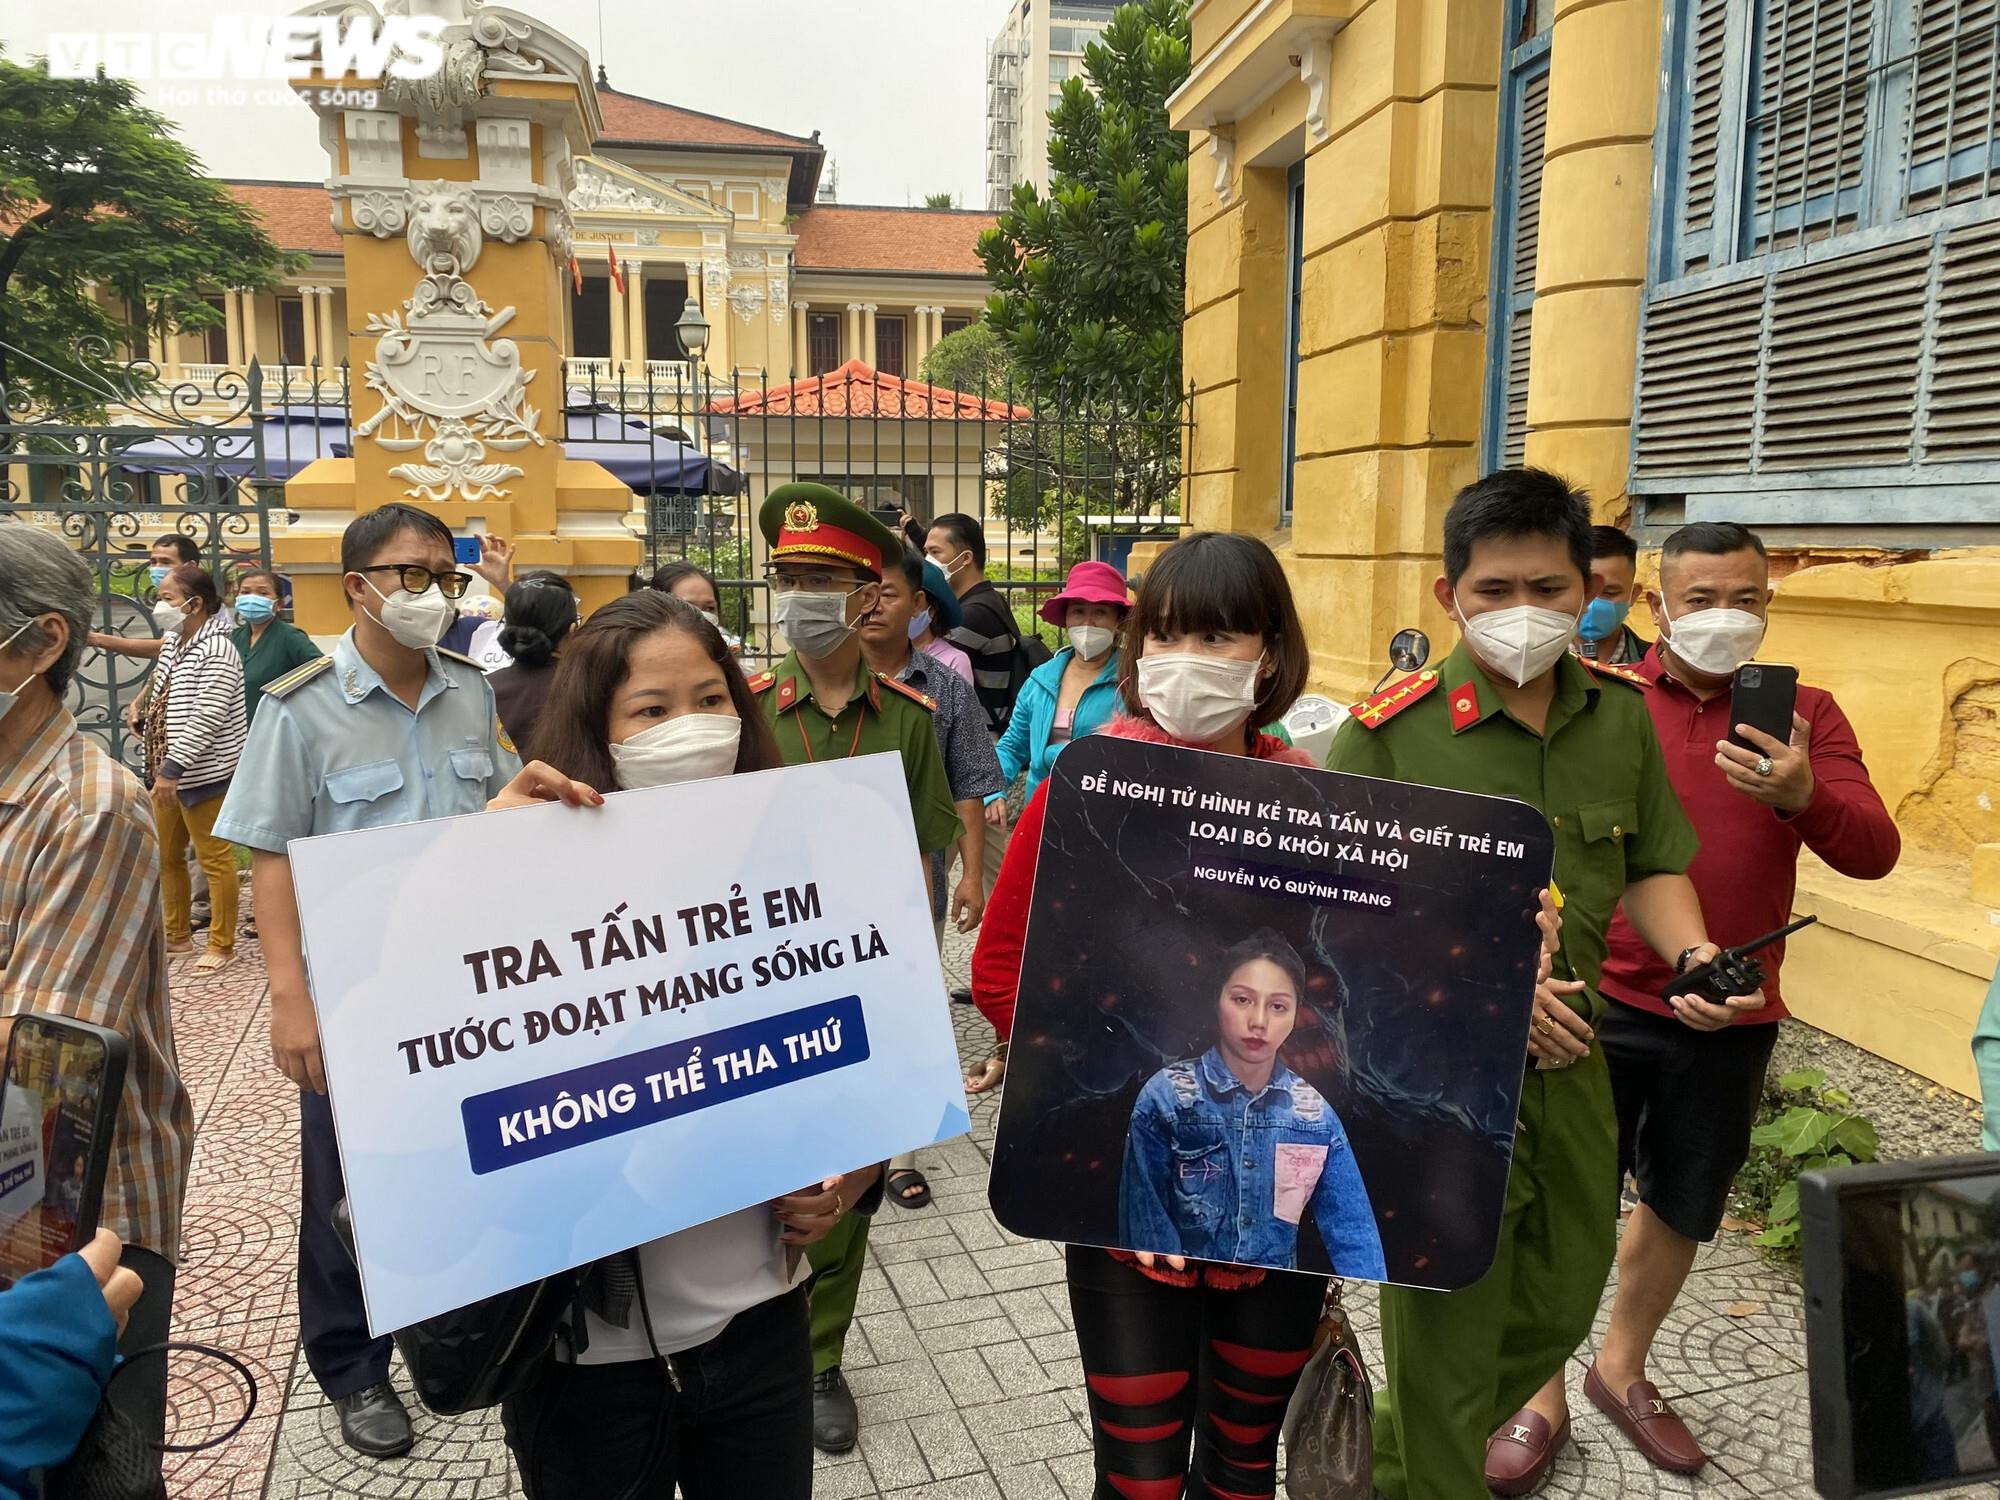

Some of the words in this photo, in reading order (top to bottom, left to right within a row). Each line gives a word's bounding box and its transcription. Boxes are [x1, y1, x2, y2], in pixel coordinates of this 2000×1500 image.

[590, 232, 624, 241] JUSTICE
[1080, 770, 1108, 794] ĐỀ
[1112, 779, 1165, 808] NGHỊ
[1171, 785, 1197, 807] TỬ
[1199, 791, 1251, 817] HÌNH
[1256, 799, 1282, 821] KẺ
[1286, 807, 1323, 828] TRA
[1329, 810, 1369, 835] TẤN
[1375, 819, 1403, 841] VÀ
[1409, 824, 1454, 848] GIẾT
[1458, 832, 1491, 854] TRẺ
[1496, 840, 1525, 859] EM
[1189, 820, 1237, 846] LOẠI
[1242, 826, 1273, 848] BỎ
[1278, 834, 1330, 858] KHỎI
[1334, 842, 1365, 863] XÃ
[1370, 847, 1409, 873] HỘI
[1193, 866, 1255, 887] NGUYỄN
[1258, 874, 1281, 890] VÕ
[1284, 880, 1338, 900] QUỲNH
[1342, 888, 1392, 907] TRANG
[463, 938, 563, 995] TRA
[570, 901, 667, 971] TẤN
[676, 883, 753, 947] TRẺ
[762, 882, 823, 929] EM
[397, 1015, 515, 1075] TƯỚC
[523, 988, 627, 1036] ĐOẠT
[636, 962, 744, 1016] MẠNG
[751, 939, 845, 988] SỐNG
[850, 923, 890, 963] LÀ
[498, 1090, 637, 1147] KHÔNG
[644, 1046, 706, 1104] THỂ
[712, 1043, 779, 1084] THA
[782, 1016, 843, 1064] THỨ
